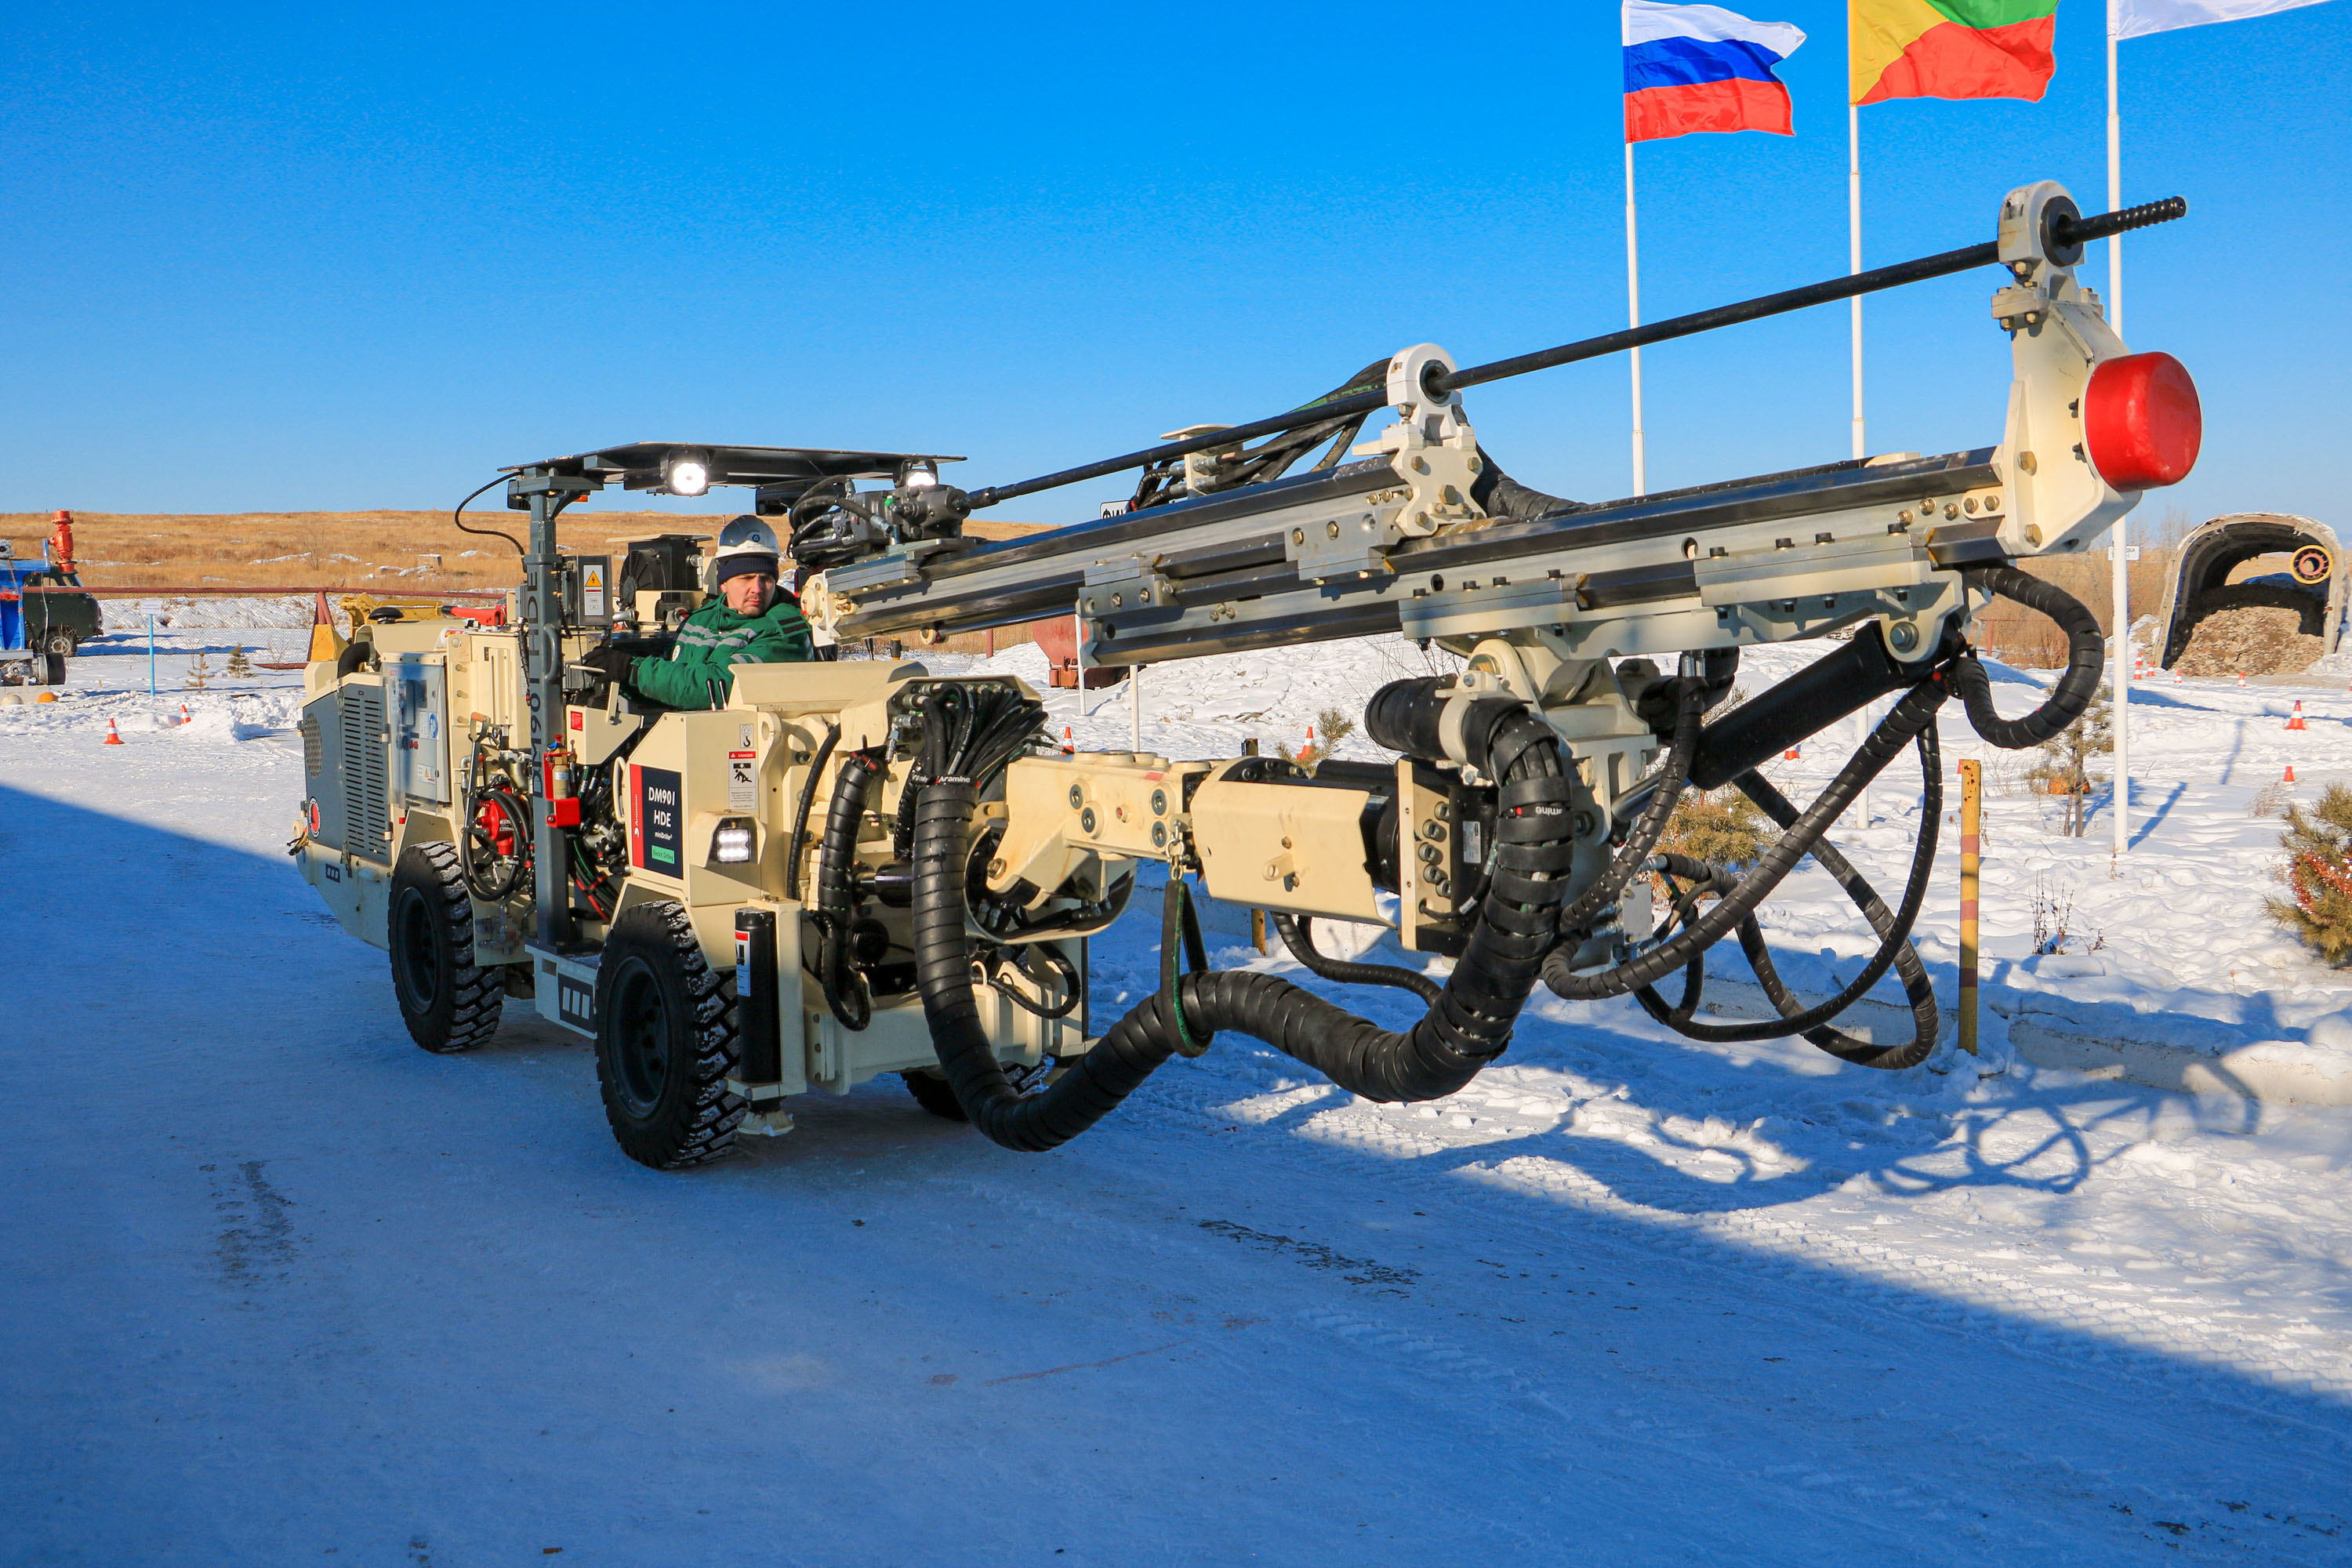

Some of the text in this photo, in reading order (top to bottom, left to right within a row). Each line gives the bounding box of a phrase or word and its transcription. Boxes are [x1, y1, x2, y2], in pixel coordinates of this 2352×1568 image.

[527, 572, 543, 798] DM901 HDE
[648, 786, 676, 806] DM901
[654, 809, 672, 827] HDE
